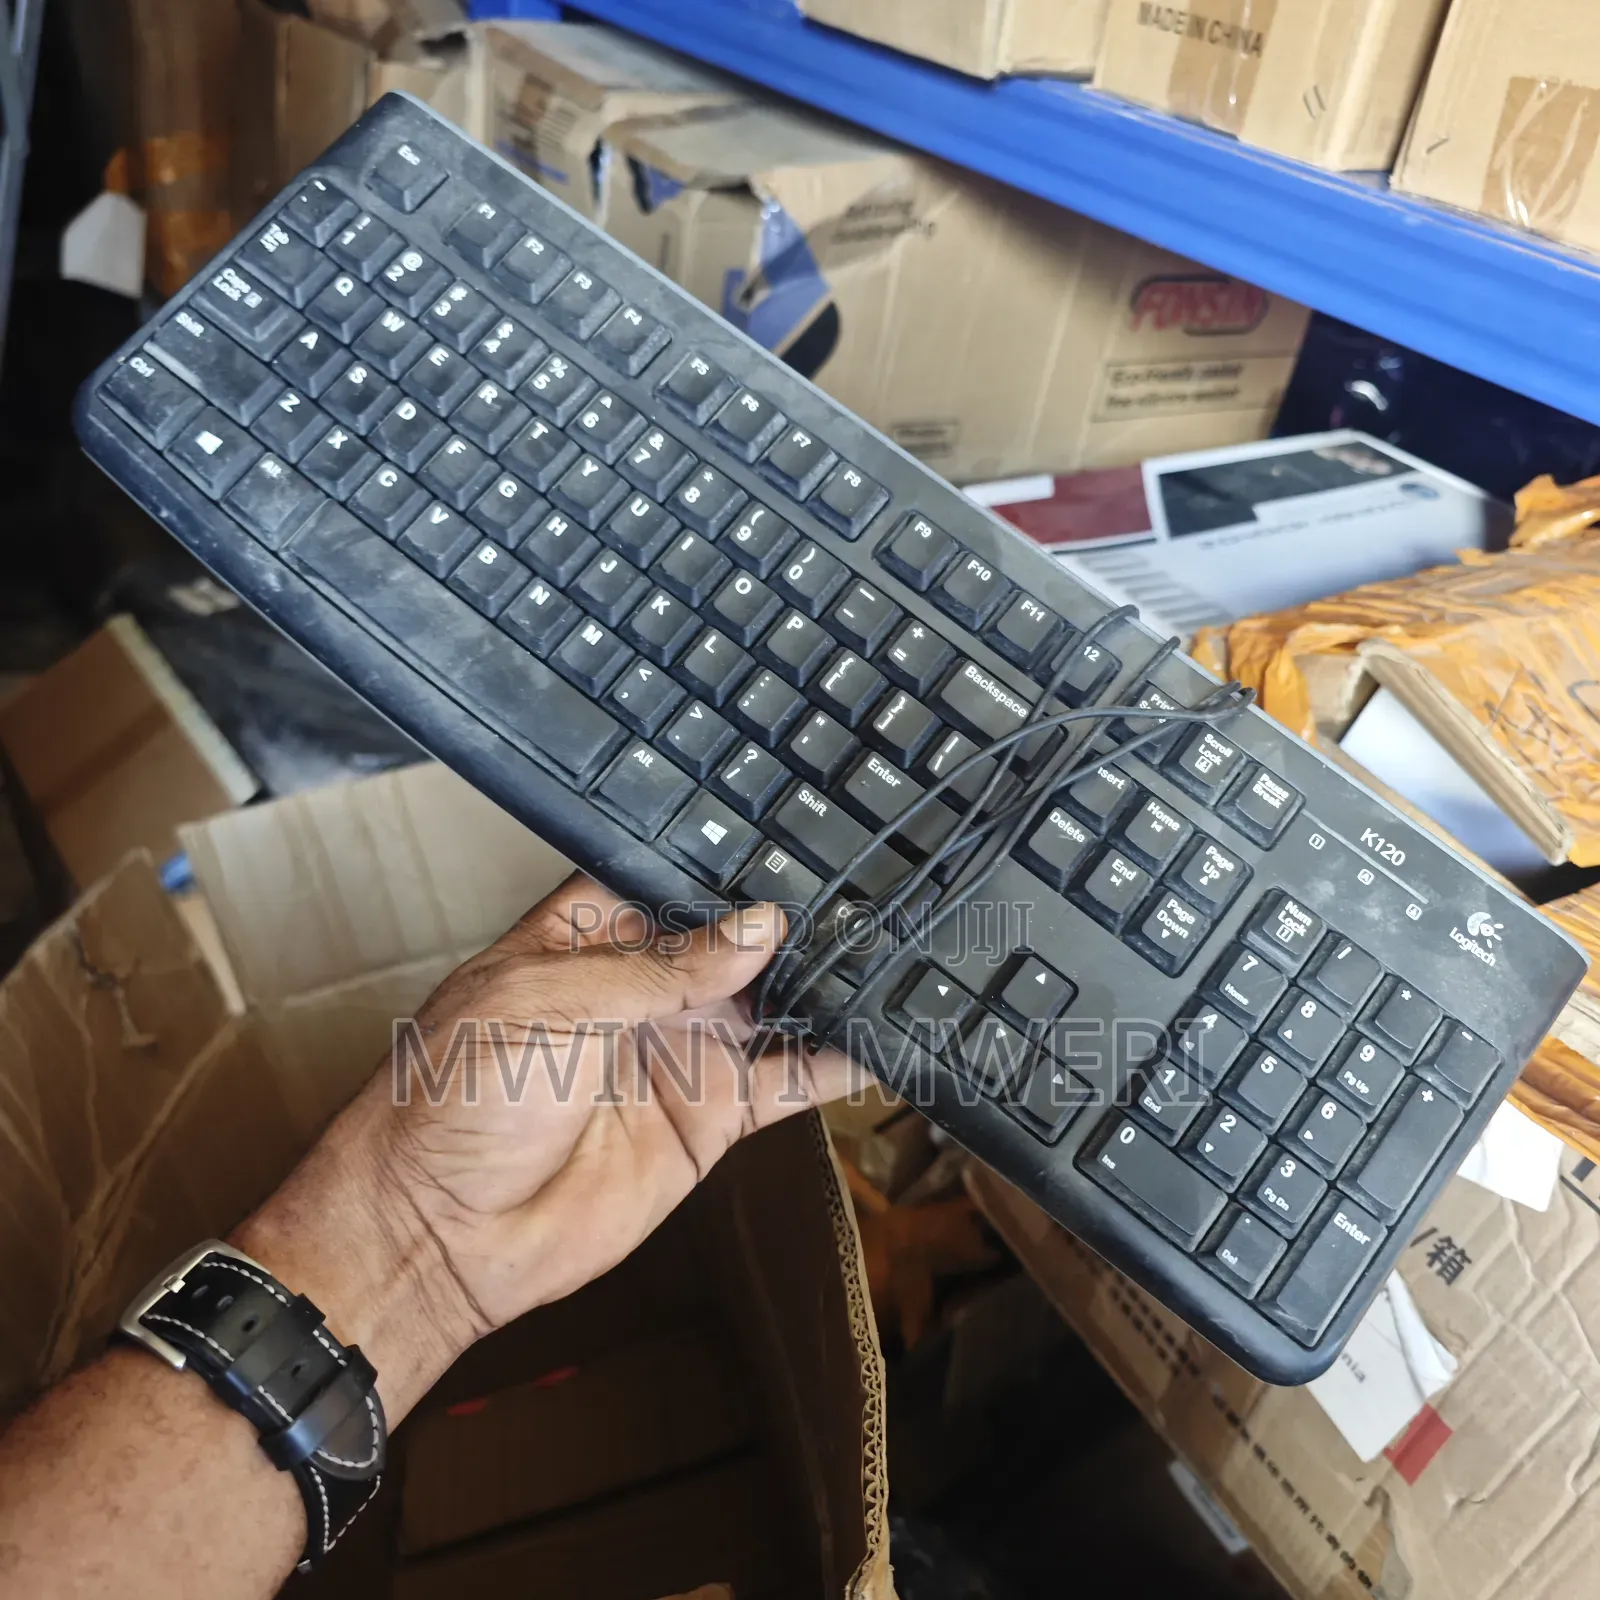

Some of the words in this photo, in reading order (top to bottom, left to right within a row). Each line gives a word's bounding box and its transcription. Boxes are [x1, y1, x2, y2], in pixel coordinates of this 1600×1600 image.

[1136, 4, 1188, 34] MADE
[1186, 13, 1206, 43] IN
[1206, 19, 1264, 58] CHINA
[397, 143, 421, 166] Esc
[478, 203, 496, 219] F1
[357, 217, 371, 230] !
[342, 232, 355, 244] 1
[525, 238, 544, 254] F2
[402, 252, 422, 271] @
[387, 266, 404, 281] 2
[574, 273, 592, 289] F3
[335, 278, 353, 296] Q
[435, 301, 451, 316] 3
[624, 309, 642, 325] F4
[382, 312, 405, 332] W
[498, 323, 513, 339] $
[300, 332, 318, 349] A
[484, 340, 501, 353] 4
[429, 348, 449, 366] E
[349, 367, 367, 383] S
[549, 358, 567, 378] %
[691, 358, 709, 375] F5
[533, 374, 550, 389] 5
[279, 394, 300, 412] Z
[479, 385, 497, 404] R
[741, 394, 759, 411] F6
[397, 402, 416, 420] D
[583, 412, 599, 427] 6
[531, 422, 548, 439] T
[328, 431, 348, 449] X
[447, 441, 466, 454] F
[649, 434, 663, 450] &
[793, 432, 811, 447] F7
[635, 448, 650, 463] 7
[261, 461, 281, 477] Alt
[582, 460, 598, 476] Y
[379, 470, 397, 487] C
[844, 470, 861, 487] F8
[499, 480, 517, 497] G
[685, 487, 700, 503] 8
[431, 507, 449, 524] V
[631, 498, 649, 516] U
[751, 510, 764, 525] (
[547, 517, 567, 536] H
[737, 526, 751, 541] 9
[915, 521, 931, 537] F9
[681, 537, 694, 550] I
[478, 546, 497, 564] B
[802, 548, 815, 563] )
[601, 560, 617, 573] J
[789, 565, 803, 579] 0
[968, 560, 991, 581] F10
[735, 578, 751, 594] O
[529, 586, 550, 605] N
[651, 596, 670, 615] K
[1021, 600, 1045, 621] F11
[787, 616, 803, 629] P
[582, 625, 603, 645] M
[705, 636, 716, 653] L
[1084, 646, 1099, 661] 12
[965, 666, 1027, 717] Backspace
[1204, 733, 1234, 758] Scroll
[633, 750, 653, 767] Alt
[744, 749, 758, 763] ?
[1198, 743, 1223, 766] Lock
[868, 758, 900, 786] Enter
[1098, 767, 1125, 789] sert
[1259, 773, 1291, 799] Pause
[799, 790, 827, 816] Shift
[1252, 784, 1282, 810] Break
[1146, 802, 1182, 832] Home
[1050, 812, 1085, 842] Delete
[1360, 827, 1407, 867] K120
[1205, 845, 1235, 872] Page
[1110, 858, 1139, 882] End
[1202, 861, 1221, 880] Up
[1167, 899, 1196, 926] Page
[1284, 900, 1313, 927] Num
[1155, 911, 1190, 939] Down
[1277, 909, 1308, 938] Lock
[1449, 926, 1497, 967] Logitech
[1243, 956, 1258, 971] 7
[1225, 984, 1248, 1005] Home
[1301, 1001, 1316, 1018] 8
[1201, 1014, 1217, 1029] 4
[1360, 1045, 1375, 1061] 9
[1261, 1056, 1277, 1073] 5
[1164, 1070, 1175, 1084] 1
[1343, 1071, 1358, 1088] Pg
[1355, 1080, 1370, 1095] Up
[1144, 1096, 1161, 1113] End
[1321, 1102, 1336, 1119] 6
[1220, 1115, 1236, 1133] 2
[1120, 1127, 1135, 1143] 0
[1102, 1155, 1115, 1169] Ins
[1281, 1160, 1295, 1177] 3
[1263, 1186, 1280, 1203] Pg
[1275, 1196, 1290, 1211] Dn
[1334, 1213, 1370, 1244] Enter
[1222, 1249, 1238, 1265] Del
